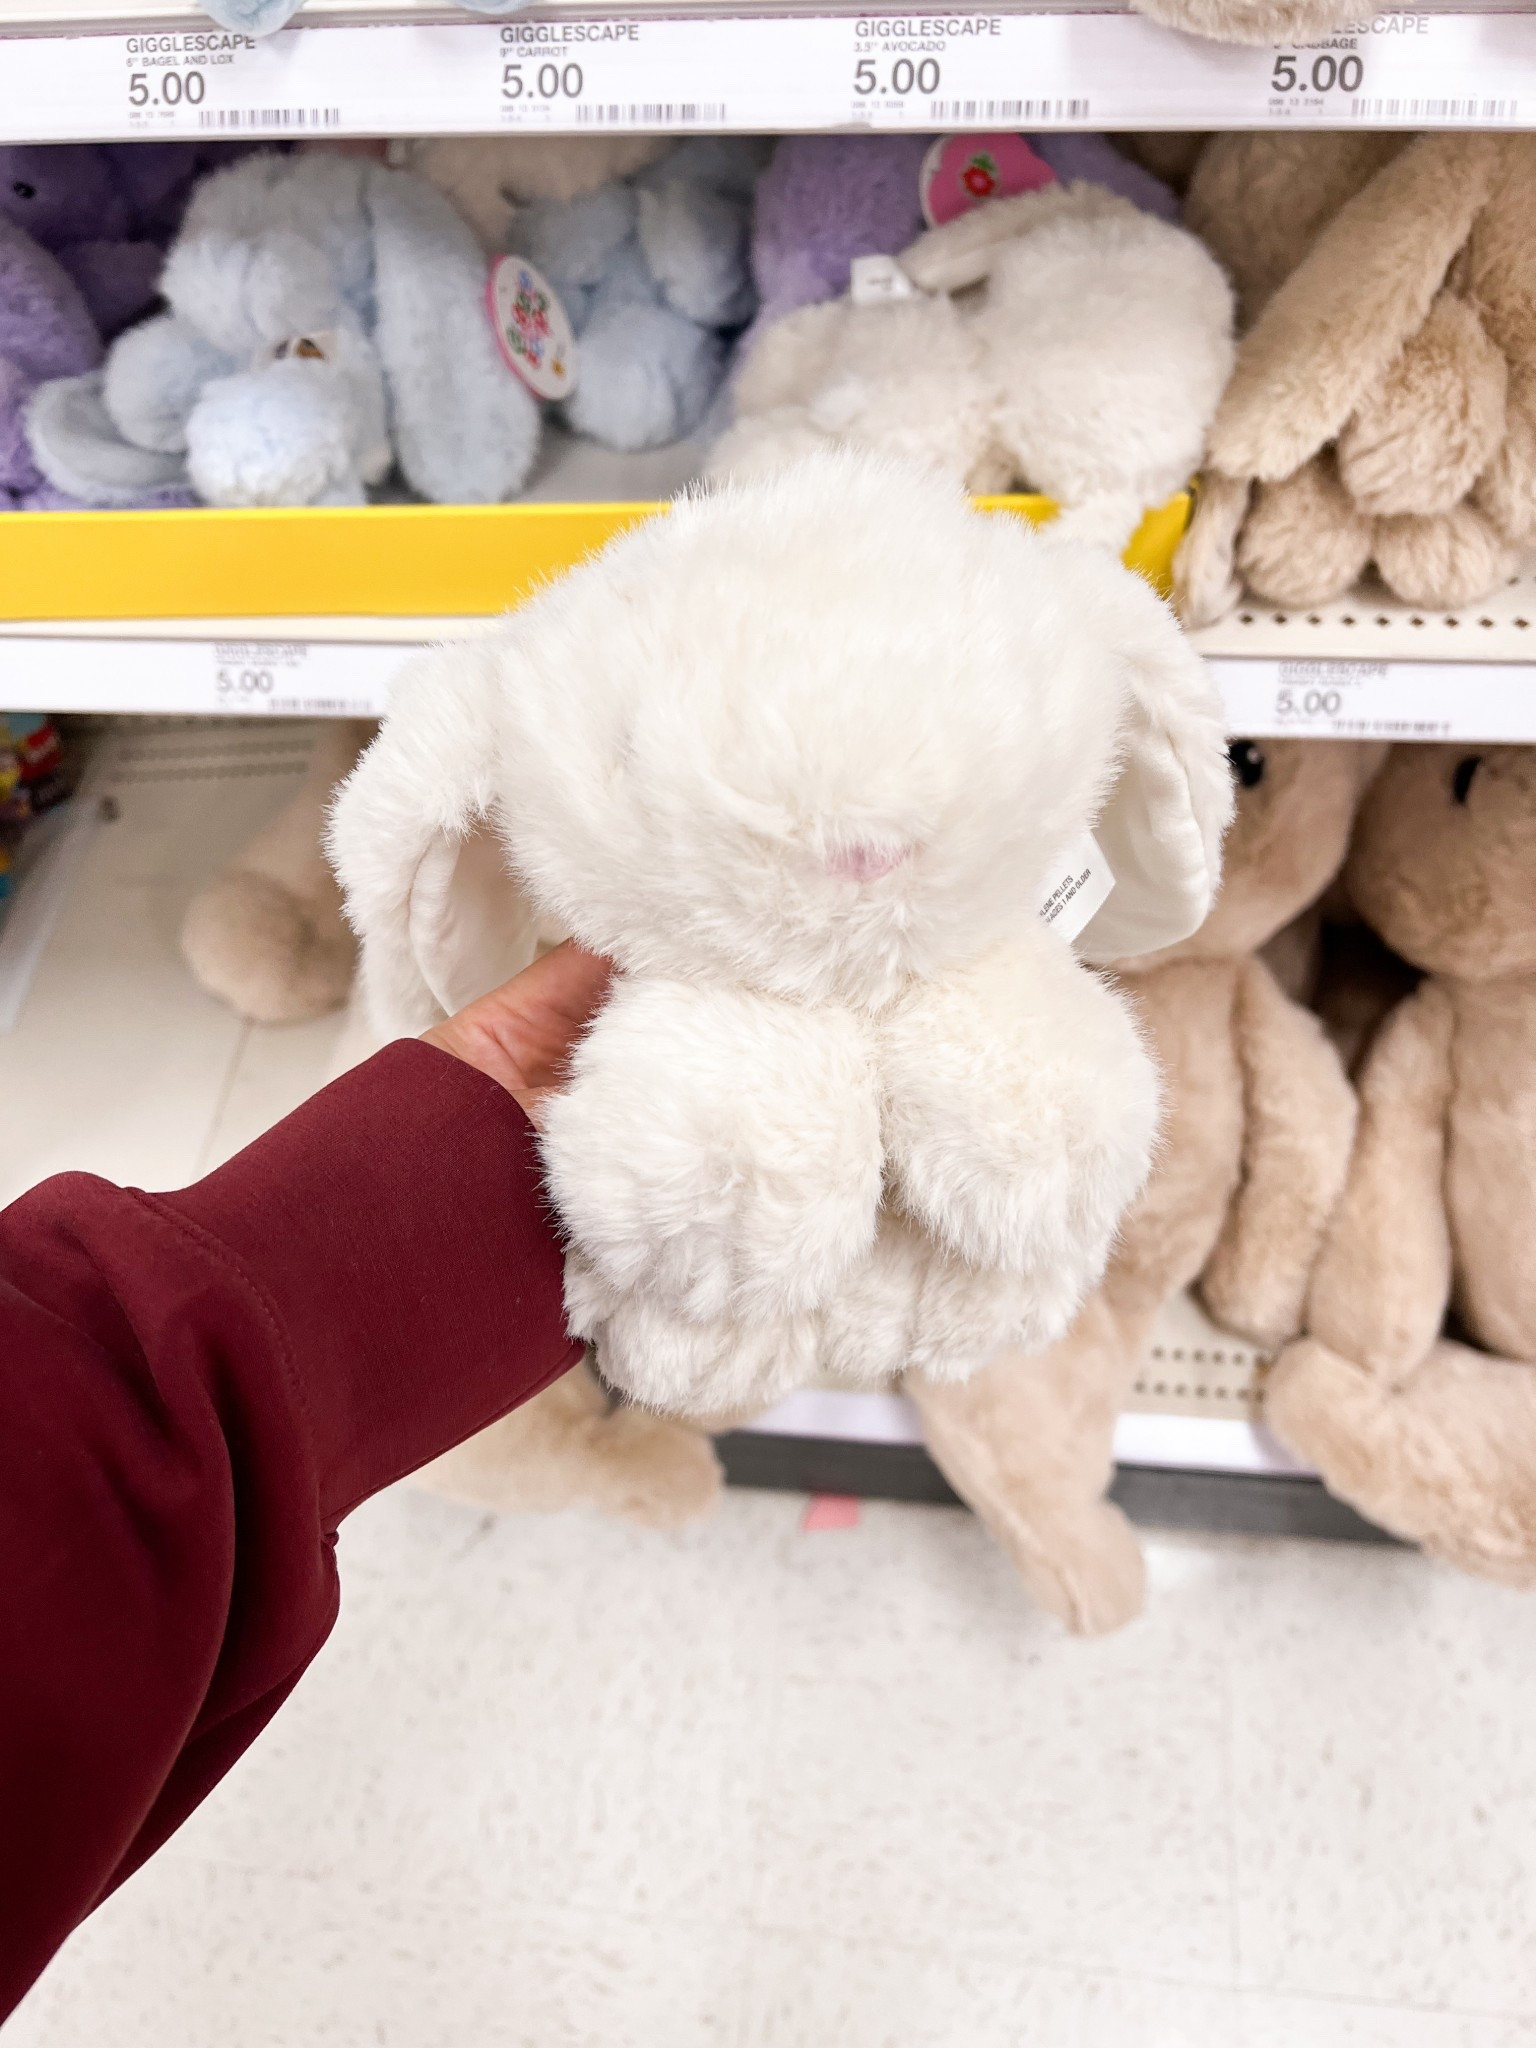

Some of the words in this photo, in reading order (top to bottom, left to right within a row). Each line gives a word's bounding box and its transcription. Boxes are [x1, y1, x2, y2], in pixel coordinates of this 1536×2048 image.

[500, 24, 640, 43] GIGGLESCAPE
[855, 19, 1001, 37] GIGGLESCAPE
[127, 34, 256, 53] GIGGLESCAPE
[516, 46, 568, 58] CARROT
[881, 40, 946, 52] AVOCADO
[142, 56, 180, 67] BAGEL
[183, 55, 208, 65] AND
[210, 54, 235, 65] LOX
[501, 62, 583, 99] 5.00
[853, 57, 941, 95] 5.00
[1271, 55, 1363, 92] 5.00
[129, 71, 205, 106] 5.00
[216, 669, 274, 694] 5.00
[1276, 689, 1342, 715] 5.00
[1052, 875, 1074, 902] PELLETS
[1065, 887, 1077, 902] AND
[1075, 868, 1091, 889] OLDER
